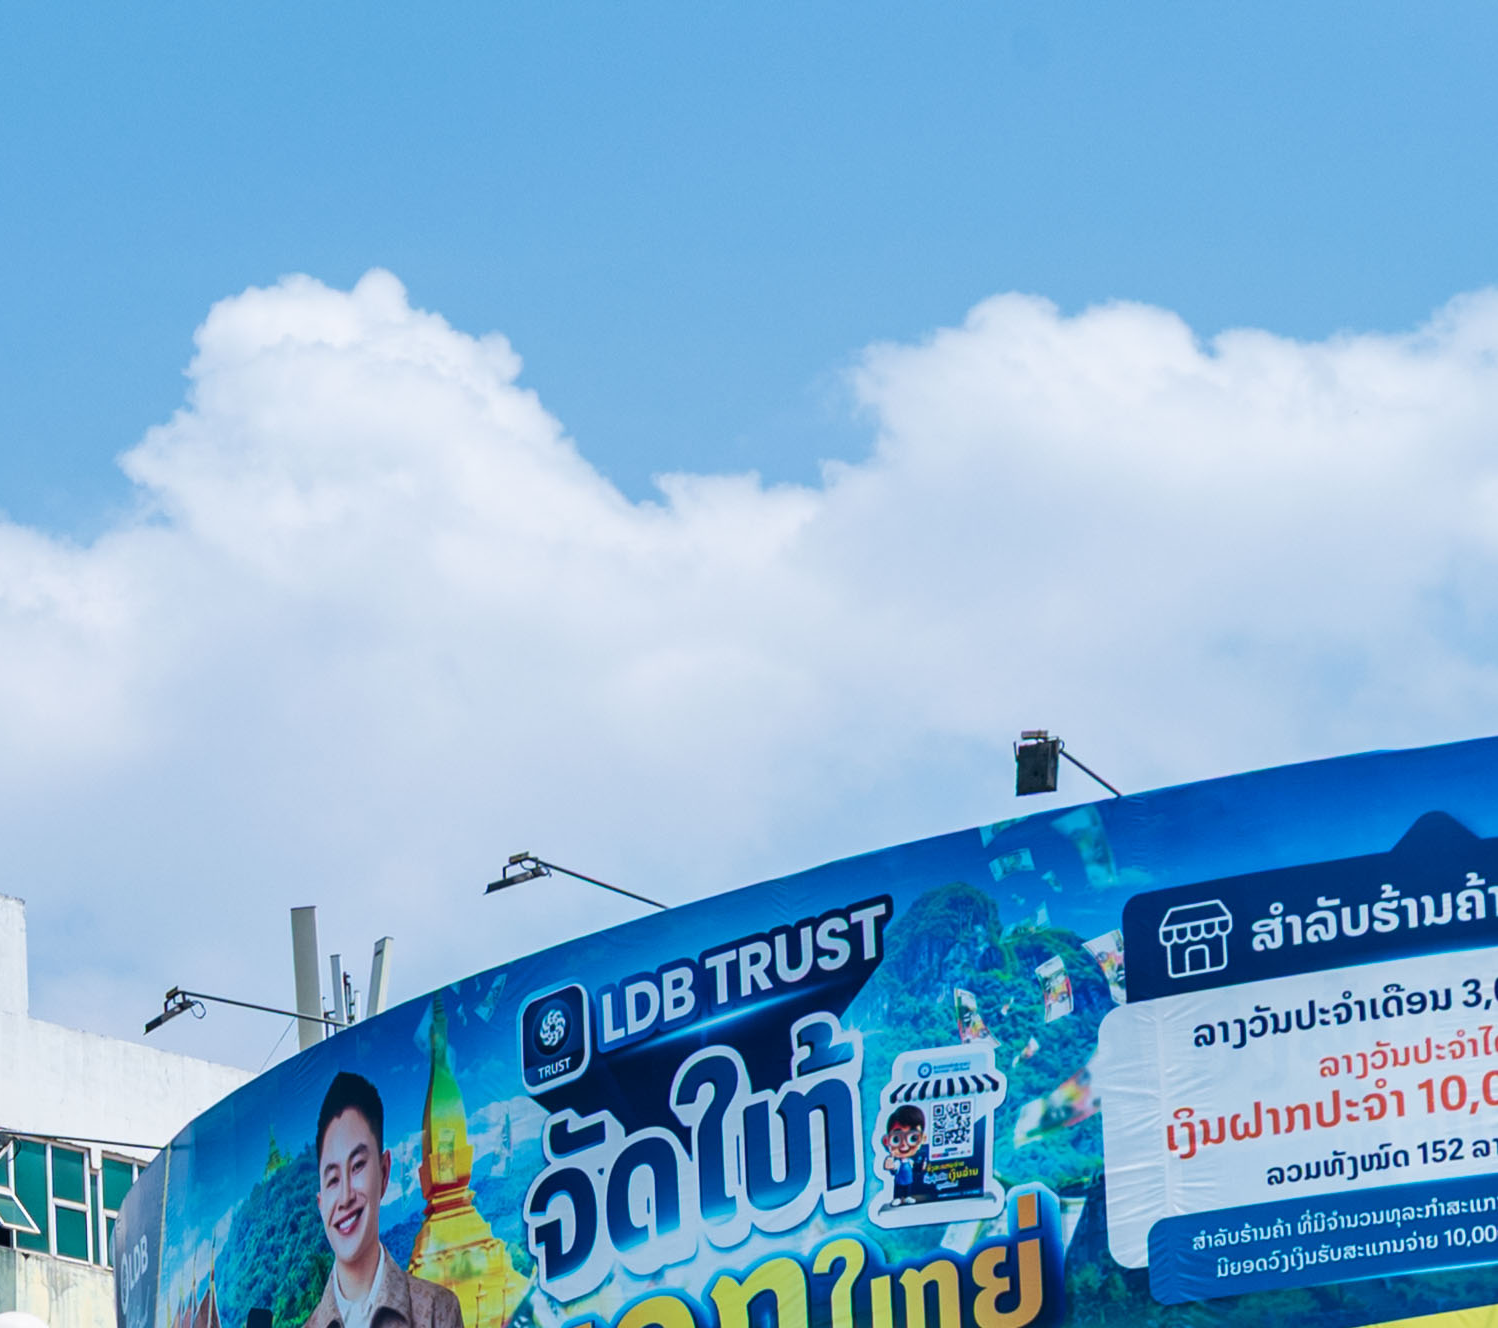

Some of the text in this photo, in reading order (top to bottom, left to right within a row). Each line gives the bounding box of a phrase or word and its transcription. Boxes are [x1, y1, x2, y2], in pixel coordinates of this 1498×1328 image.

[601, 903, 887, 1044] LDB TRUST
[1461, 978, 1498, 1010] 3,
[537, 1056, 572, 1080] TRUST
[1318, 1025, 1498, 1080] ລາງວັນປະຈຳໄ
[1165, 1078, 1406, 1160] ເງິນຝາກປະຈຳ
[526, 1018, 858, 1286] ຈັດໃຫ້
[1416, 1137, 1465, 1166] 152
[1296, 1195, 1498, 1236] ທີ່ມີຈຳນວນທຸລະກຳສະແກ
[127, 1234, 149, 1291] LDB
